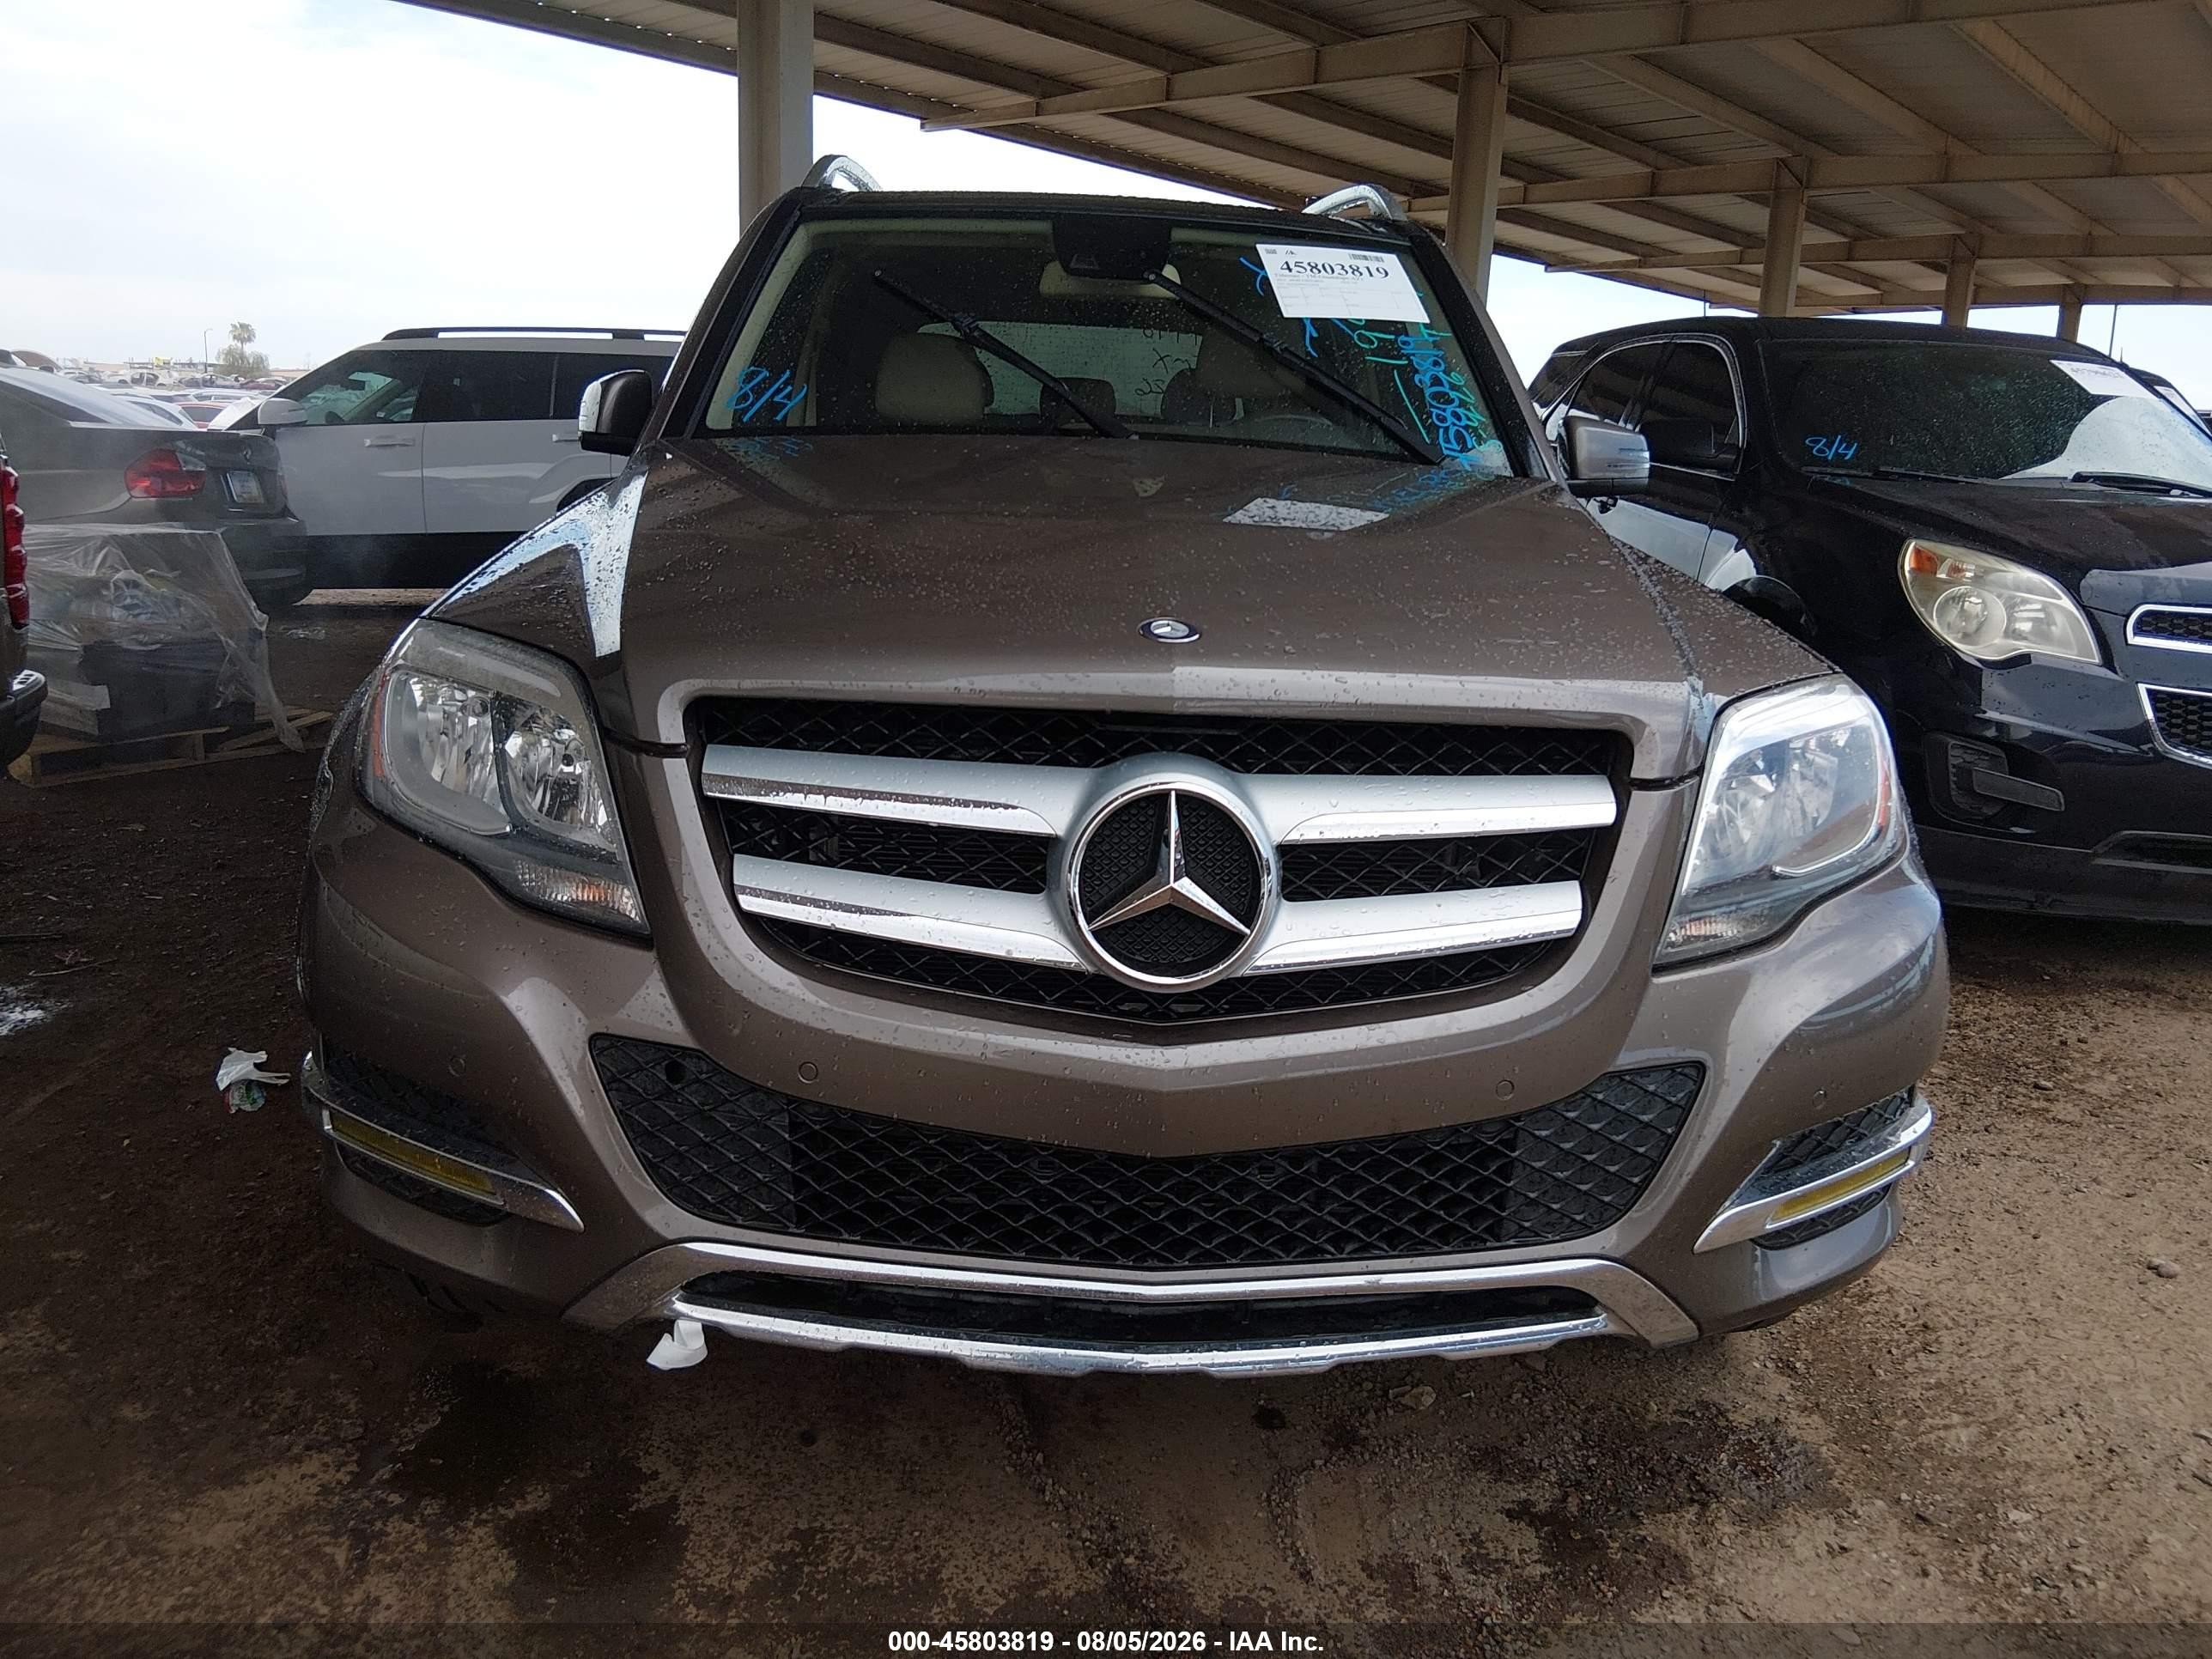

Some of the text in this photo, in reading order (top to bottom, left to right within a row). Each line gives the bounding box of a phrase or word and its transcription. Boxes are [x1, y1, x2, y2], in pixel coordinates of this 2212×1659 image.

[1280, 260, 1389, 279] 45803819
[726, 366, 808, 422] 8/4
[1805, 434, 1858, 460] 8/4
